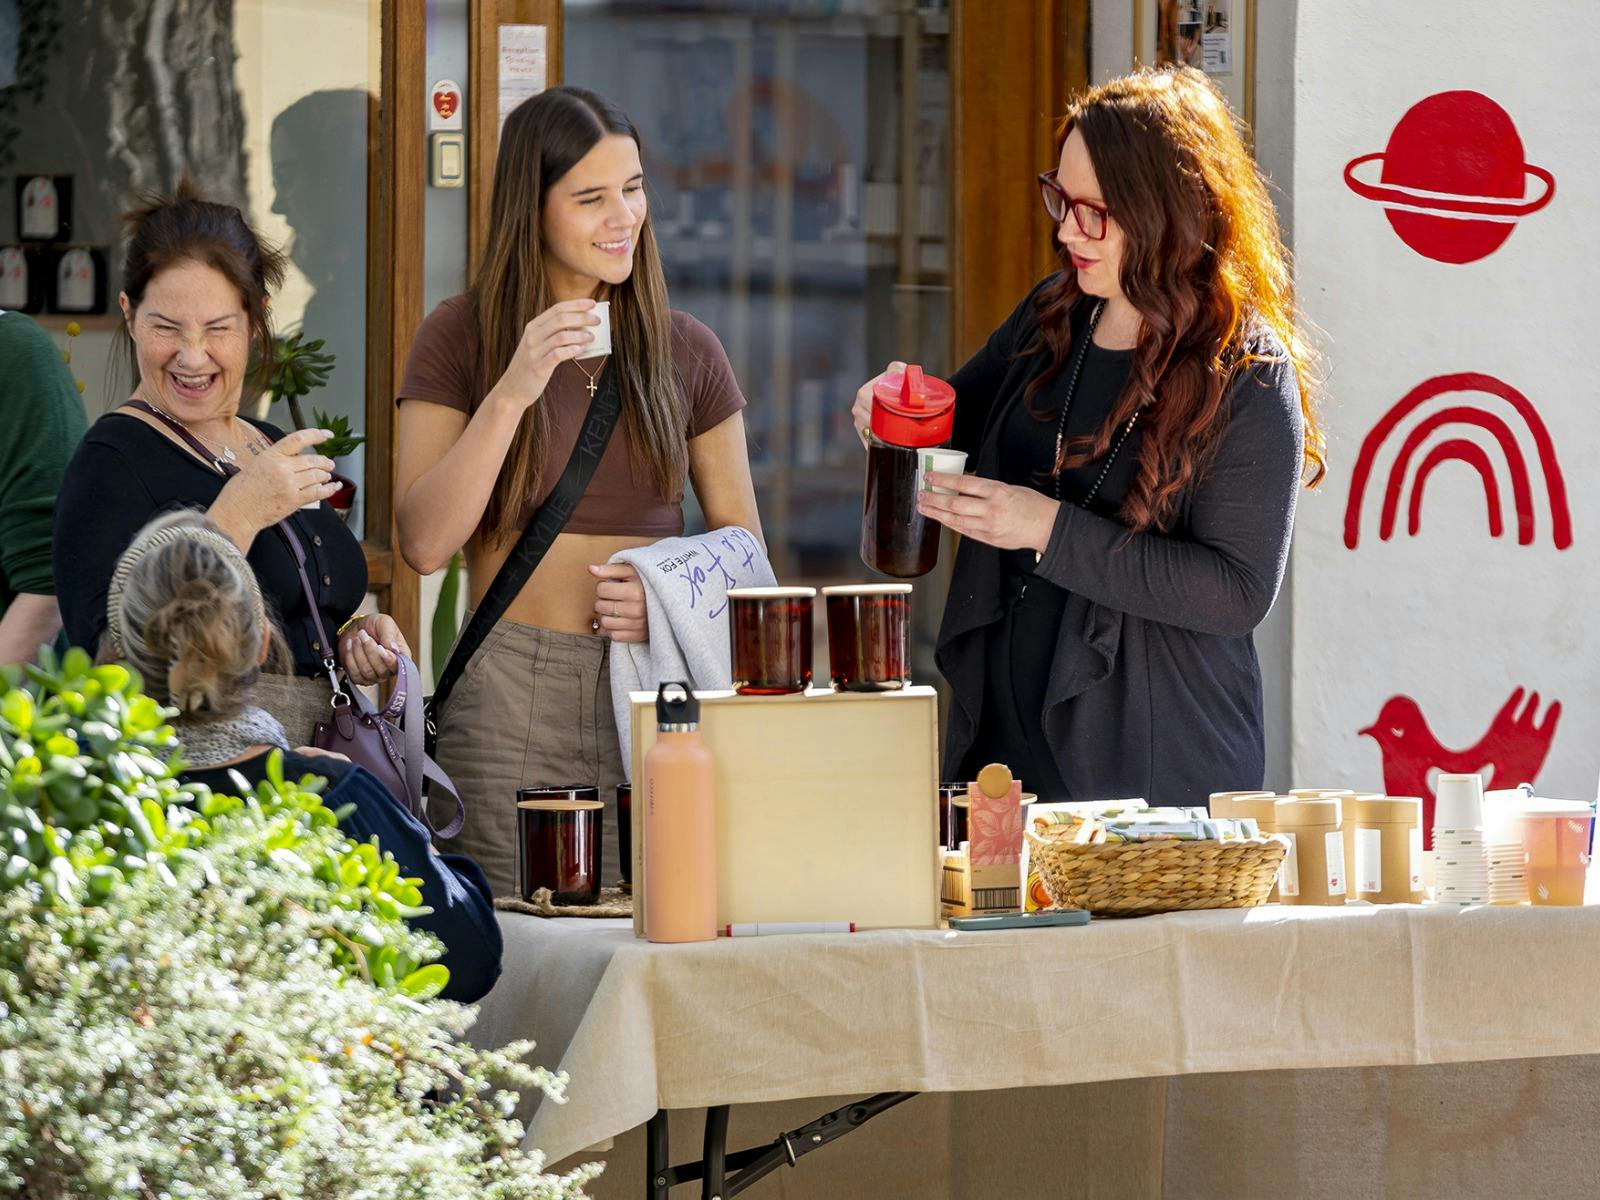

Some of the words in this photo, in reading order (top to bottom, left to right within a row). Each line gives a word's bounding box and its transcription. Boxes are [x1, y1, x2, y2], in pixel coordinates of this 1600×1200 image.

[518, 494, 573, 565] KYLIE
[677, 549, 700, 565] WHITE
[662, 562, 678, 574] FOX
